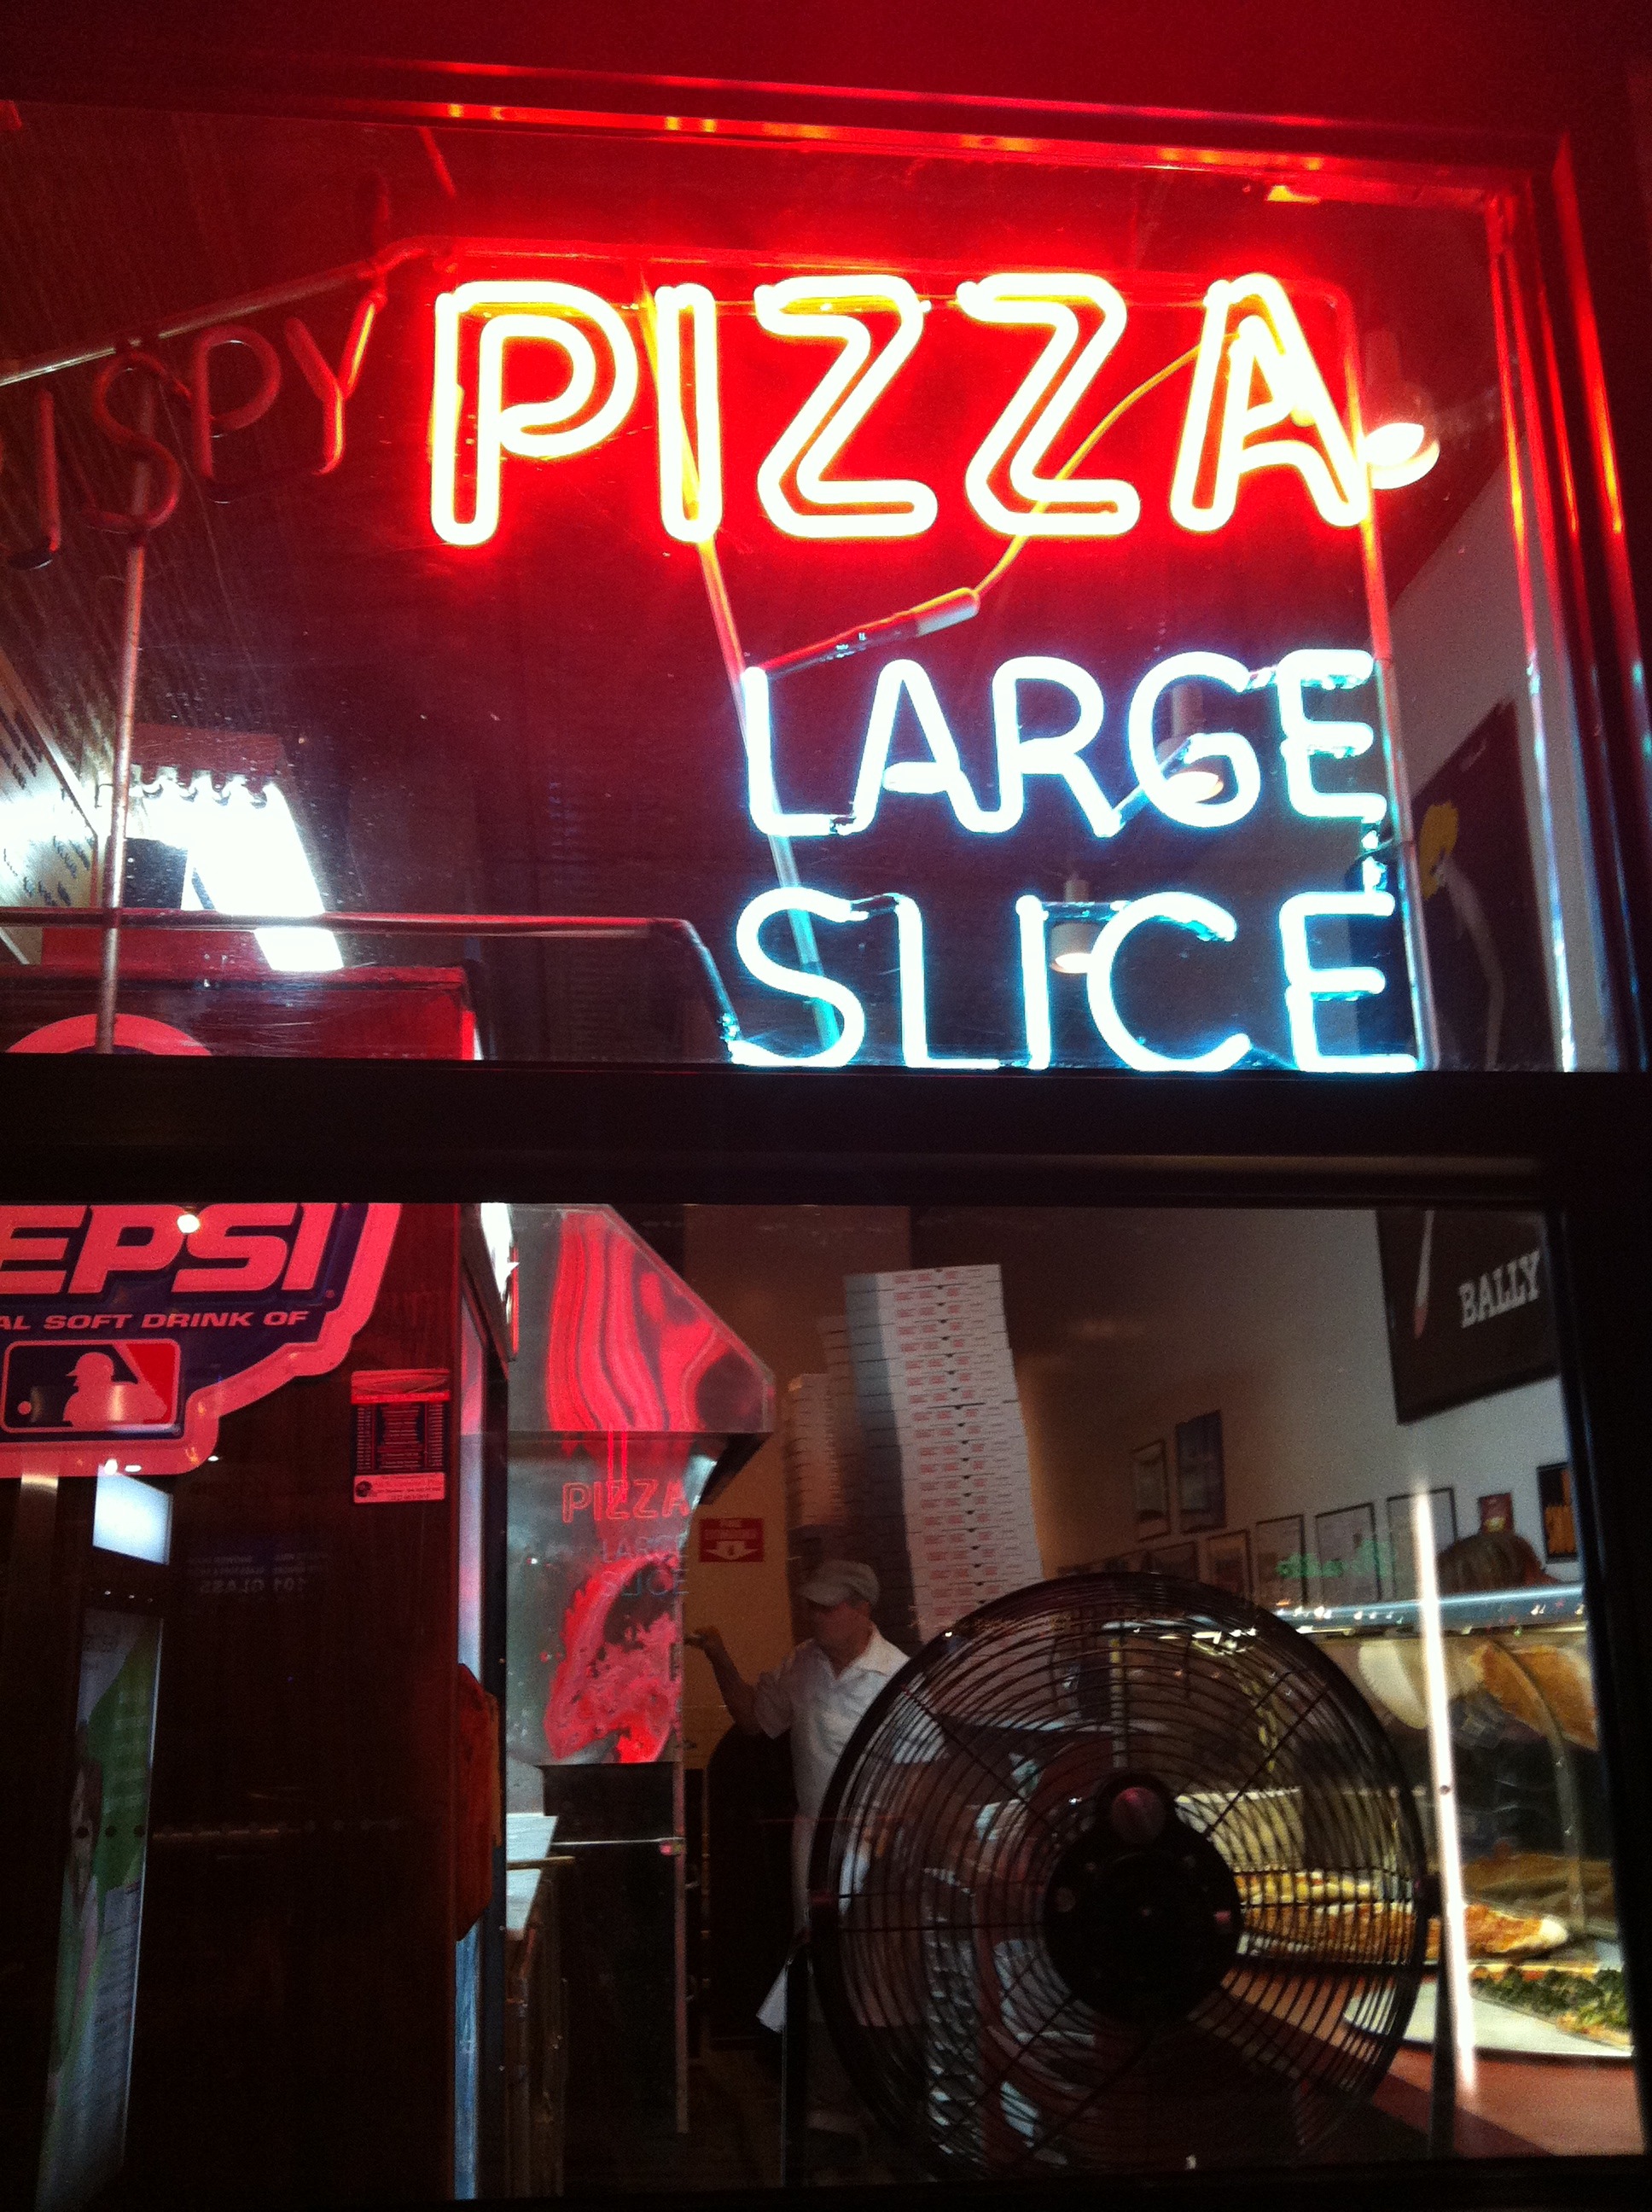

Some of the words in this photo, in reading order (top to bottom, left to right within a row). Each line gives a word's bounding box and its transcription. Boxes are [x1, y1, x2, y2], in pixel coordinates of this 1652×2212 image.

[430, 271, 1370, 546] PIZZA
[739, 649, 1387, 838] LARGE
[730, 885, 1418, 1074] SLICE
[0, 1202, 338, 1295] EPSI
[1457, 1247, 1540, 1328] BALLY
[43, 1313, 133, 1330] SOFT
[141, 1312, 256, 1329] DRINK
[263, 1310, 311, 1326] OF
[561, 1478, 691, 1524] PIZZA
